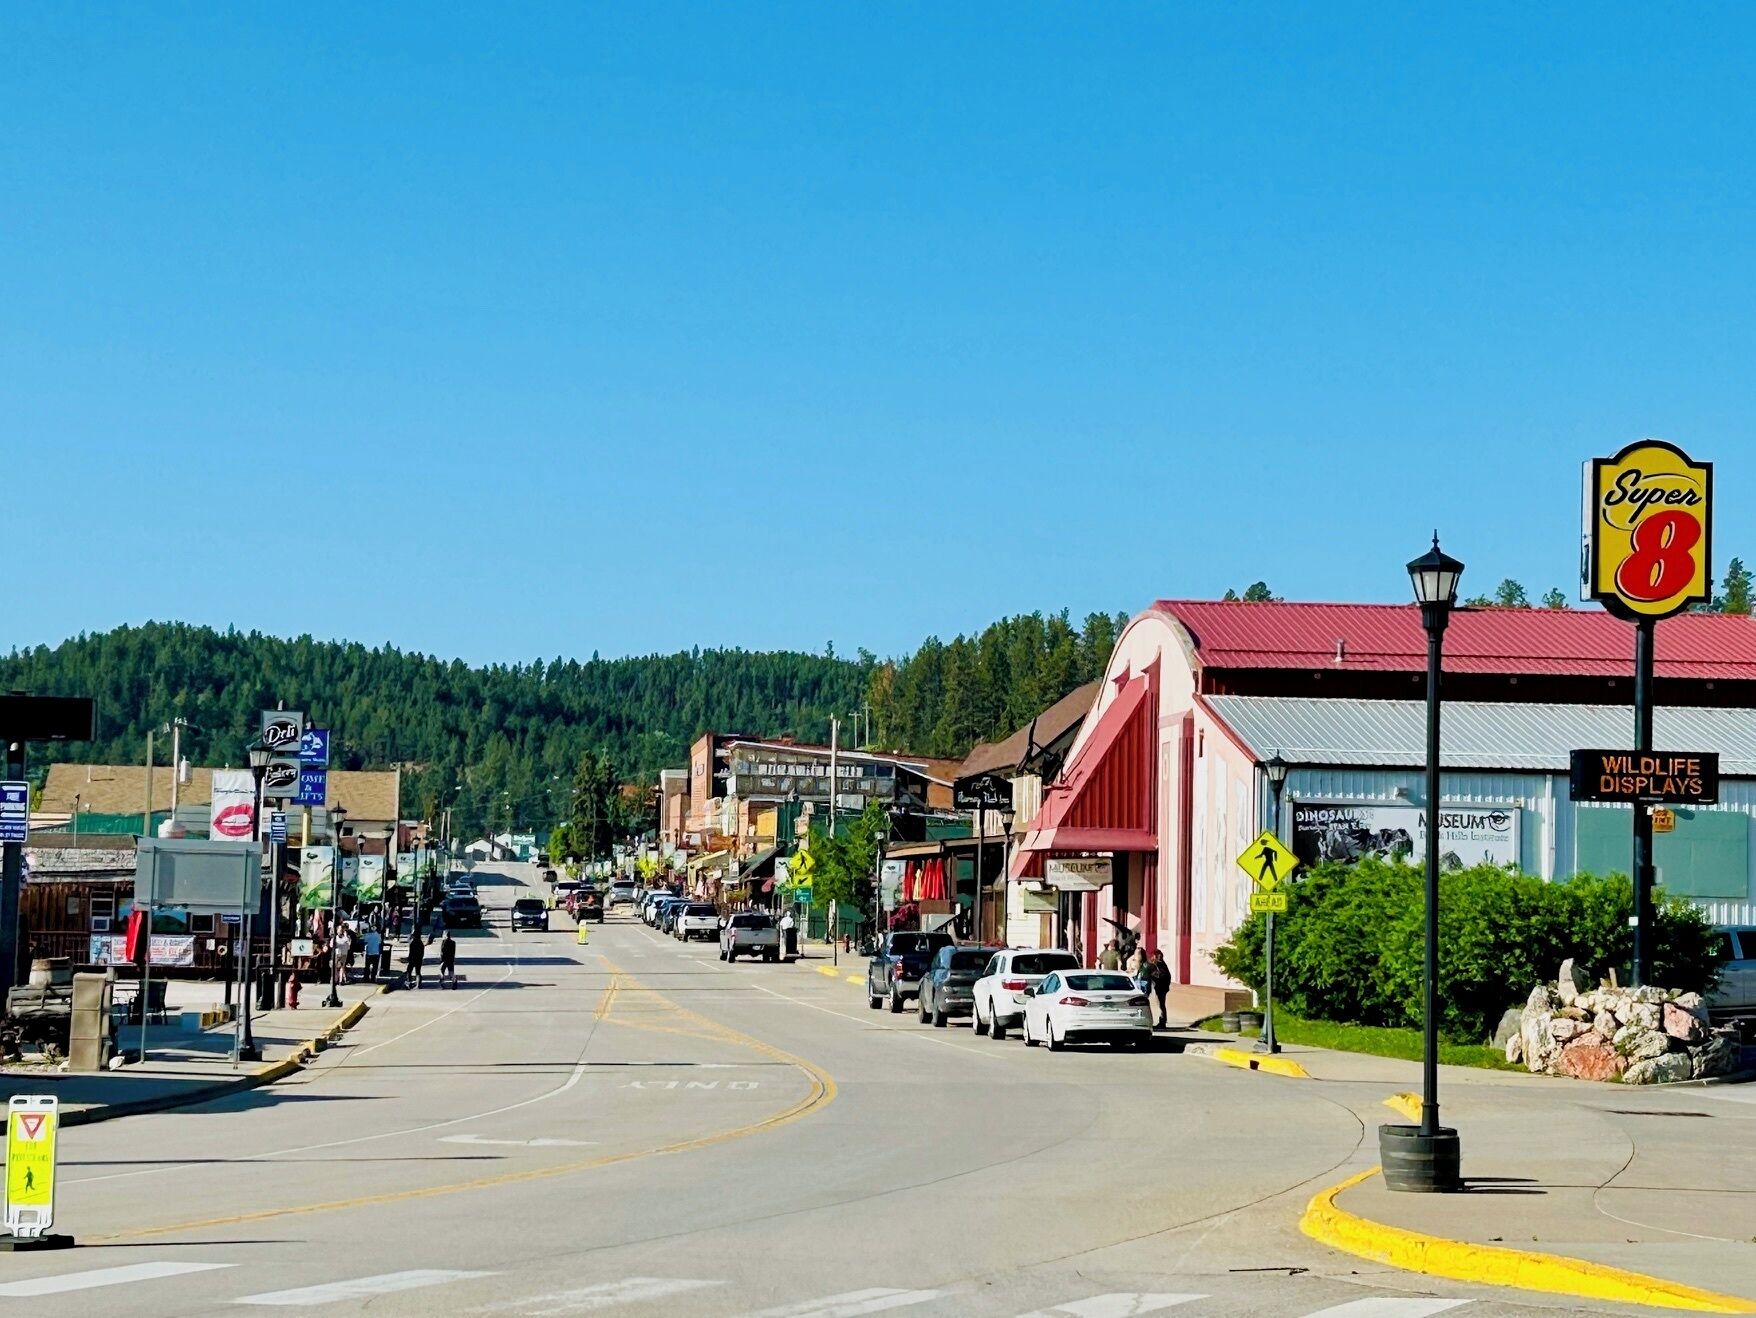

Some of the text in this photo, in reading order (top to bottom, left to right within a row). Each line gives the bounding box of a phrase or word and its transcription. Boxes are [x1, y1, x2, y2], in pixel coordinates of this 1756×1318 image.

[1604, 468, 1702, 524] Super
[1614, 509, 1701, 603] 8
[263, 723, 296, 743] Deli
[1601, 756, 1701, 776] WILDLIFE
[1600, 775, 1703, 795] DISPLAYS
[616, 1080, 760, 1090] ONLY
